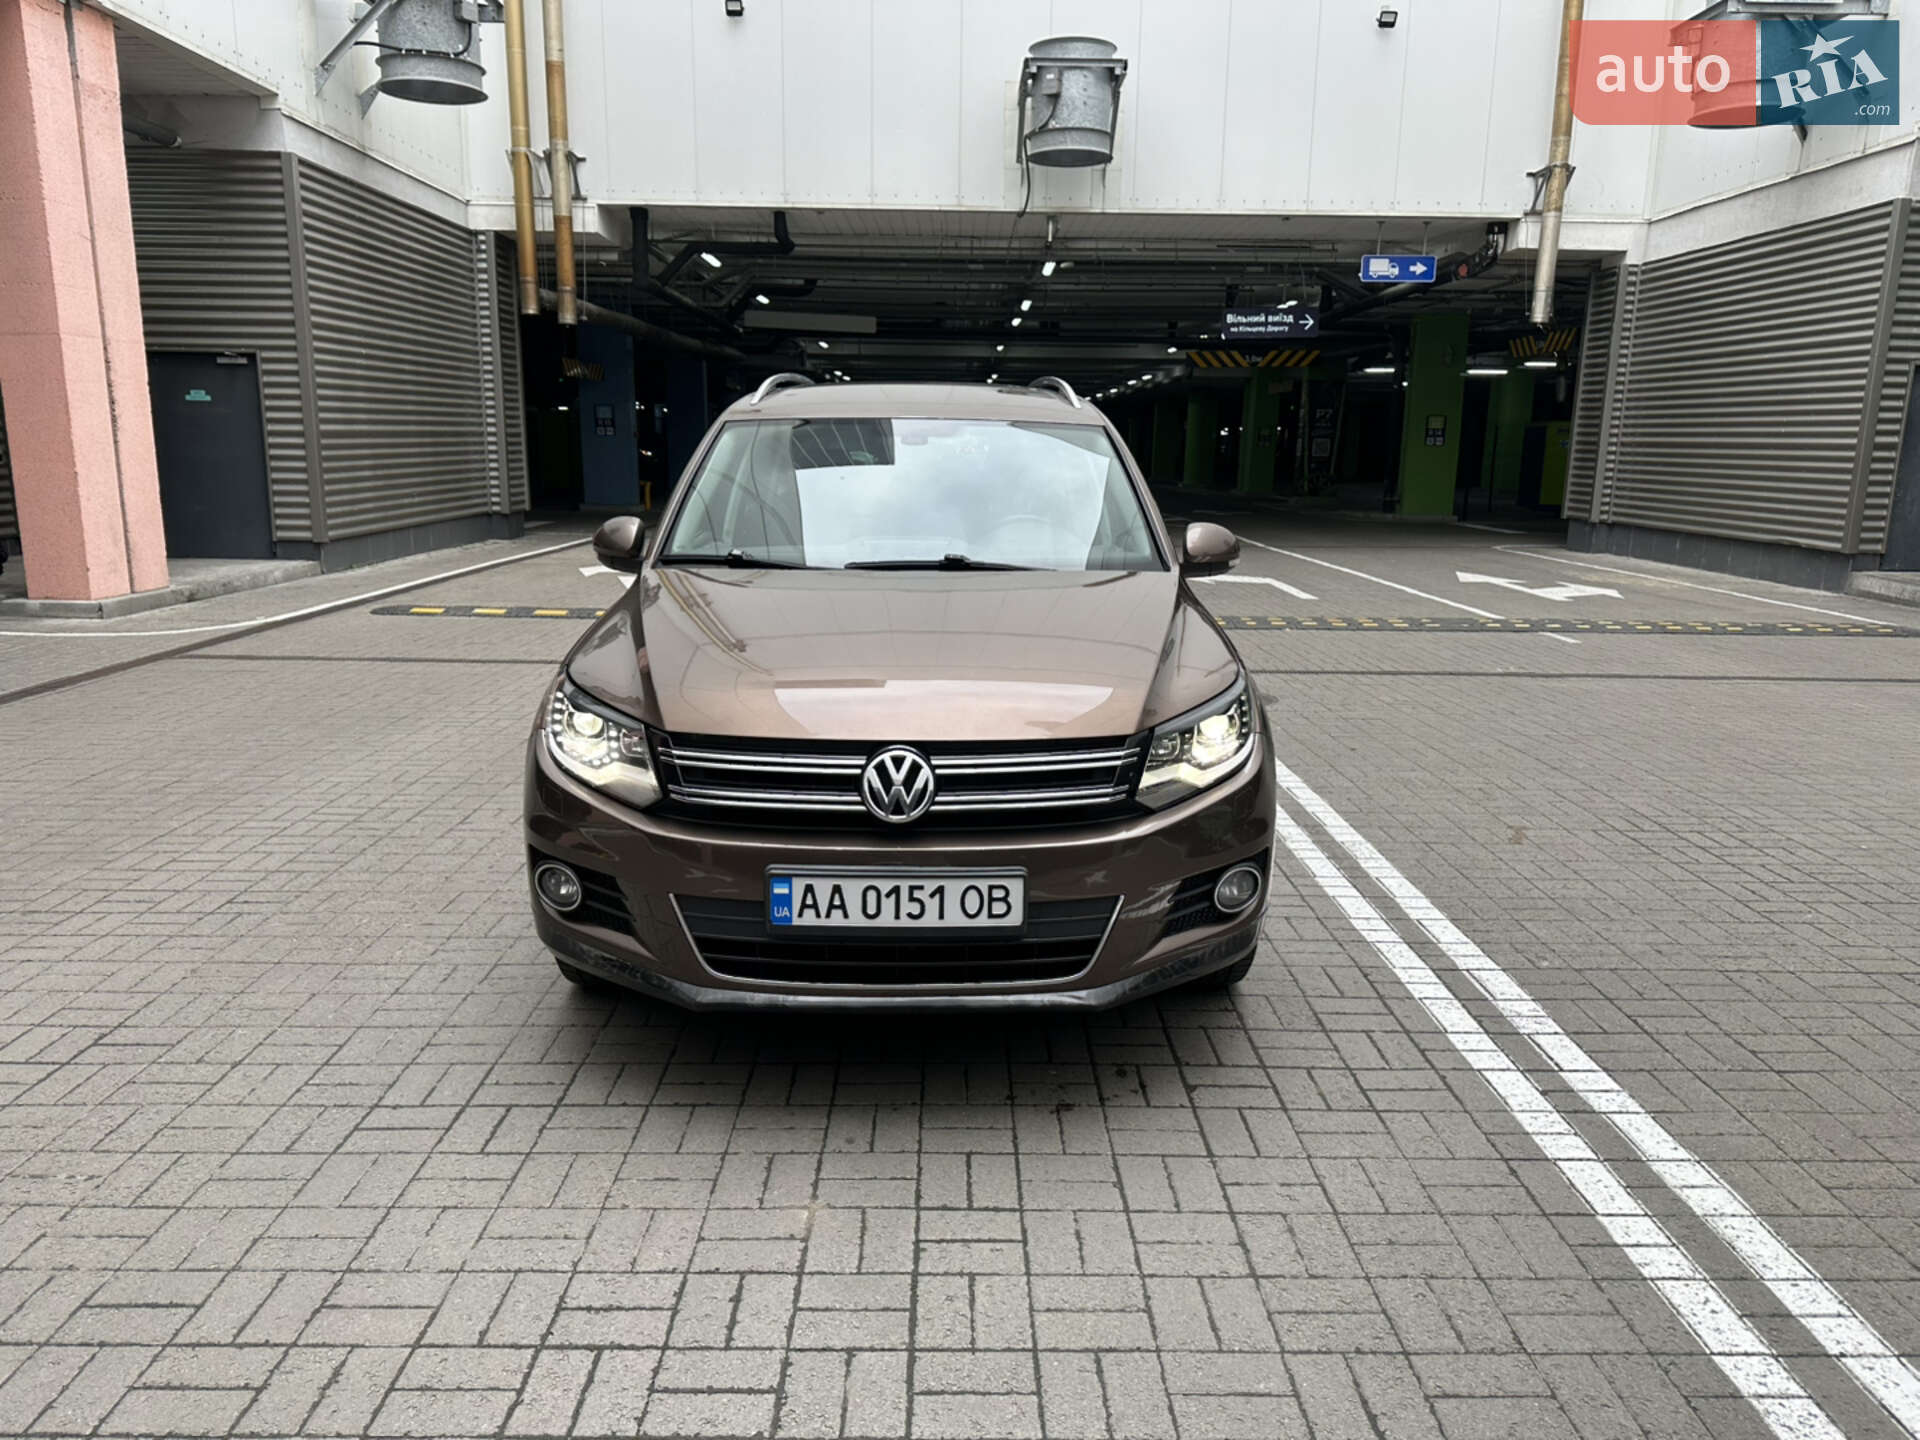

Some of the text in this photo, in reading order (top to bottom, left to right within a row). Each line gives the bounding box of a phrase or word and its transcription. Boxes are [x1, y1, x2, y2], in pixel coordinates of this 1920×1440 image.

[1226, 313, 1294, 324] Вільний виїзд
[797, 883, 1012, 921] AA 0151 OB
[774, 906, 790, 917] UA
